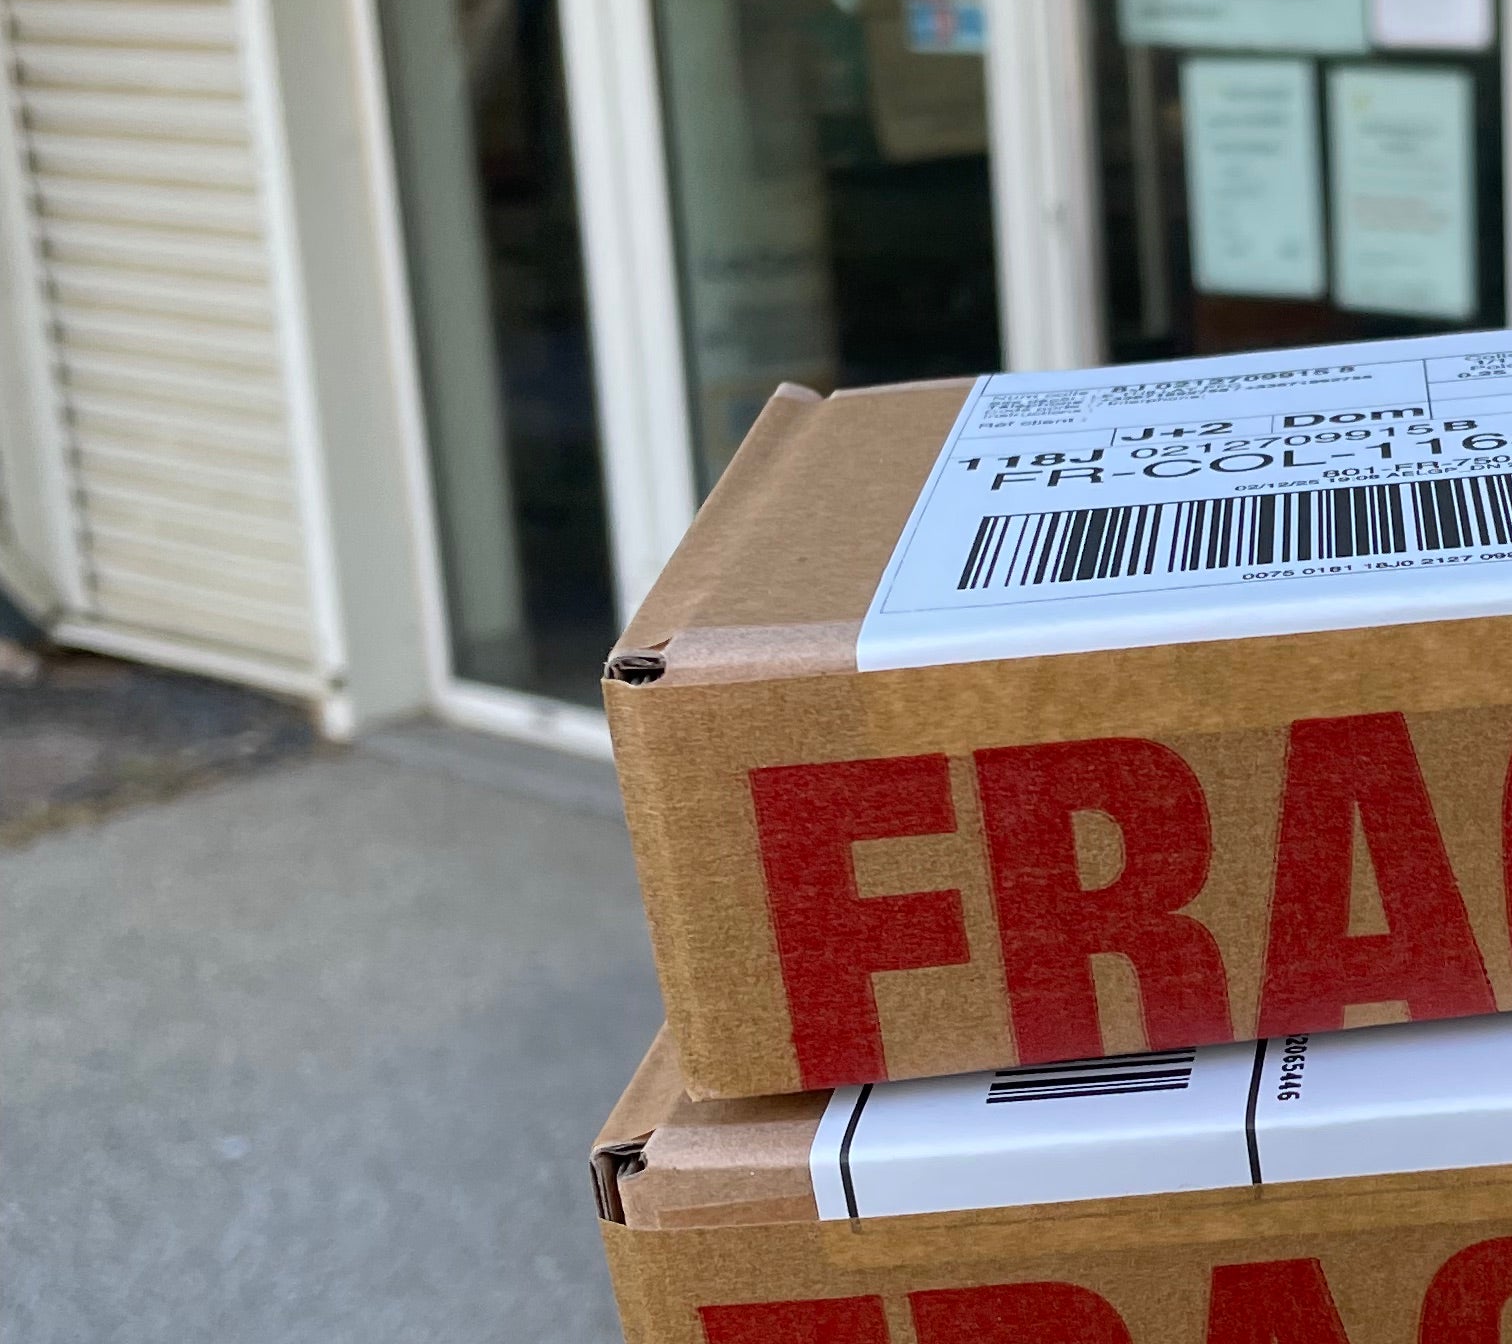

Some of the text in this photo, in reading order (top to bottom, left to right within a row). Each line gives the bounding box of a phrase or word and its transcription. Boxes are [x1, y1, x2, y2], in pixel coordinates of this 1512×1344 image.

[1283, 407, 1424, 428] Dom
[1121, 422, 1233, 442] J+2
[958, 449, 1105, 471] 118J
[1242, 570, 1296, 580] 0075
